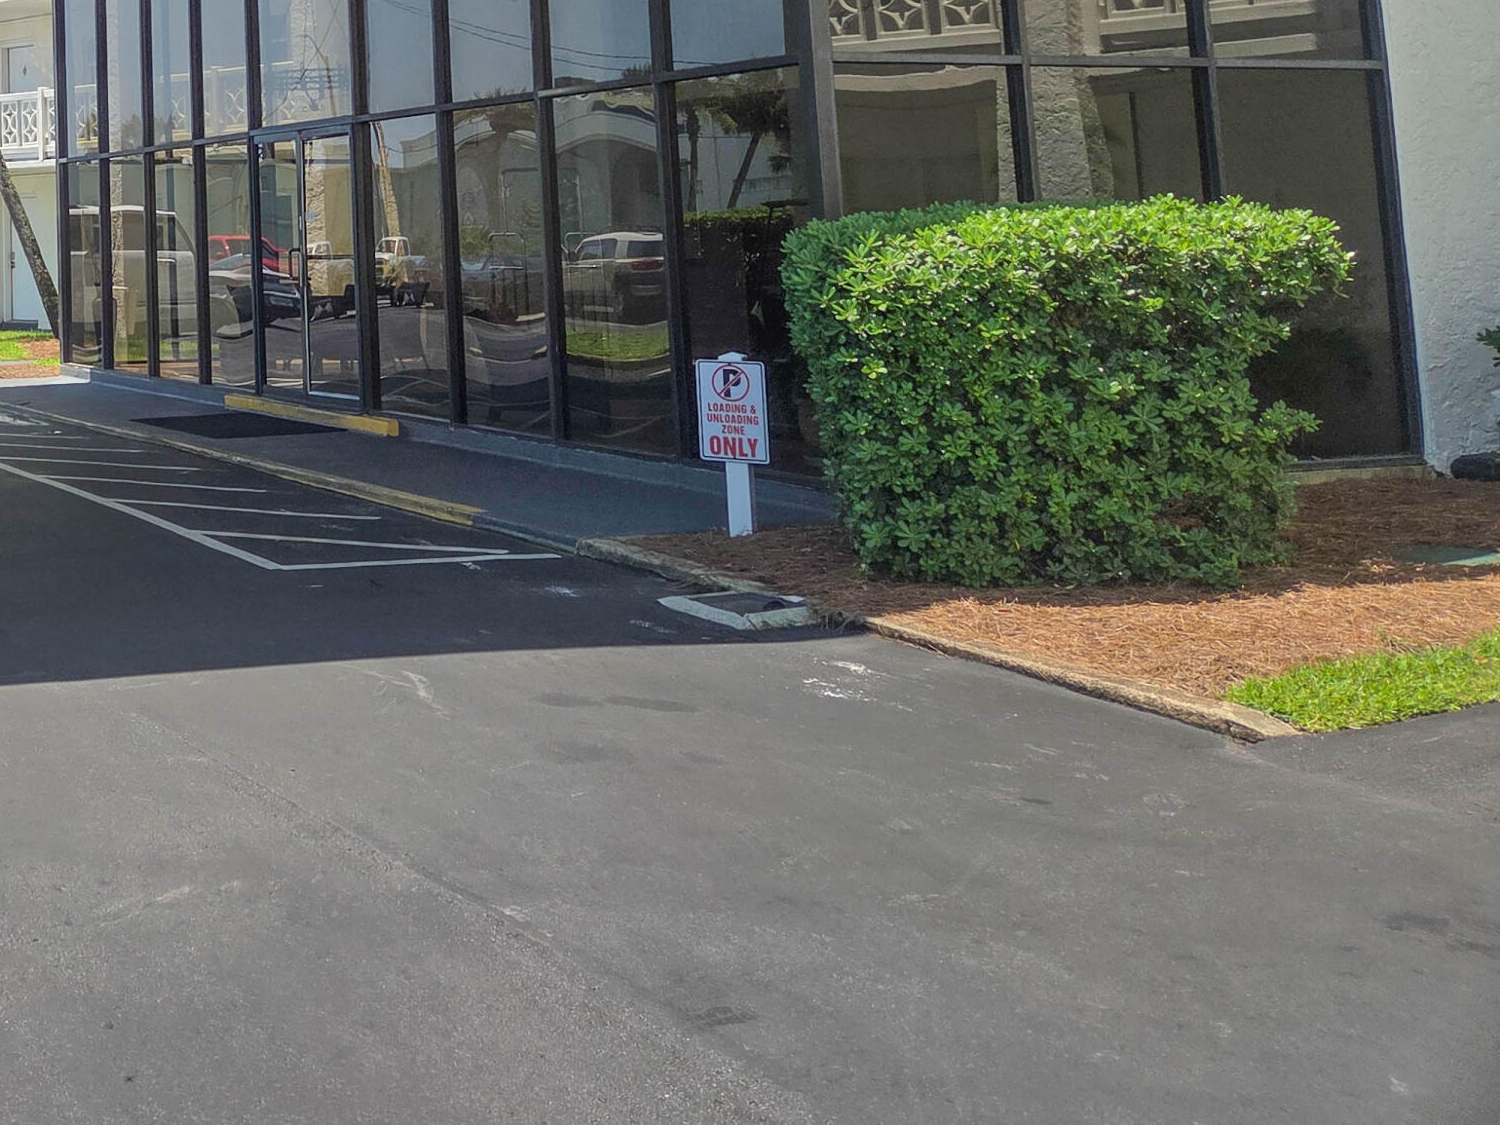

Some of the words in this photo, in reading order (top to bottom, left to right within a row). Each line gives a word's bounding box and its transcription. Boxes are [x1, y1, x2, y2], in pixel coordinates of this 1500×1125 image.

[708, 402, 747, 413] LOADING
[749, 405, 757, 414] &
[707, 413, 759, 425] UNLOADING
[721, 425, 746, 435] ZONE
[709, 435, 758, 458] ONLY
